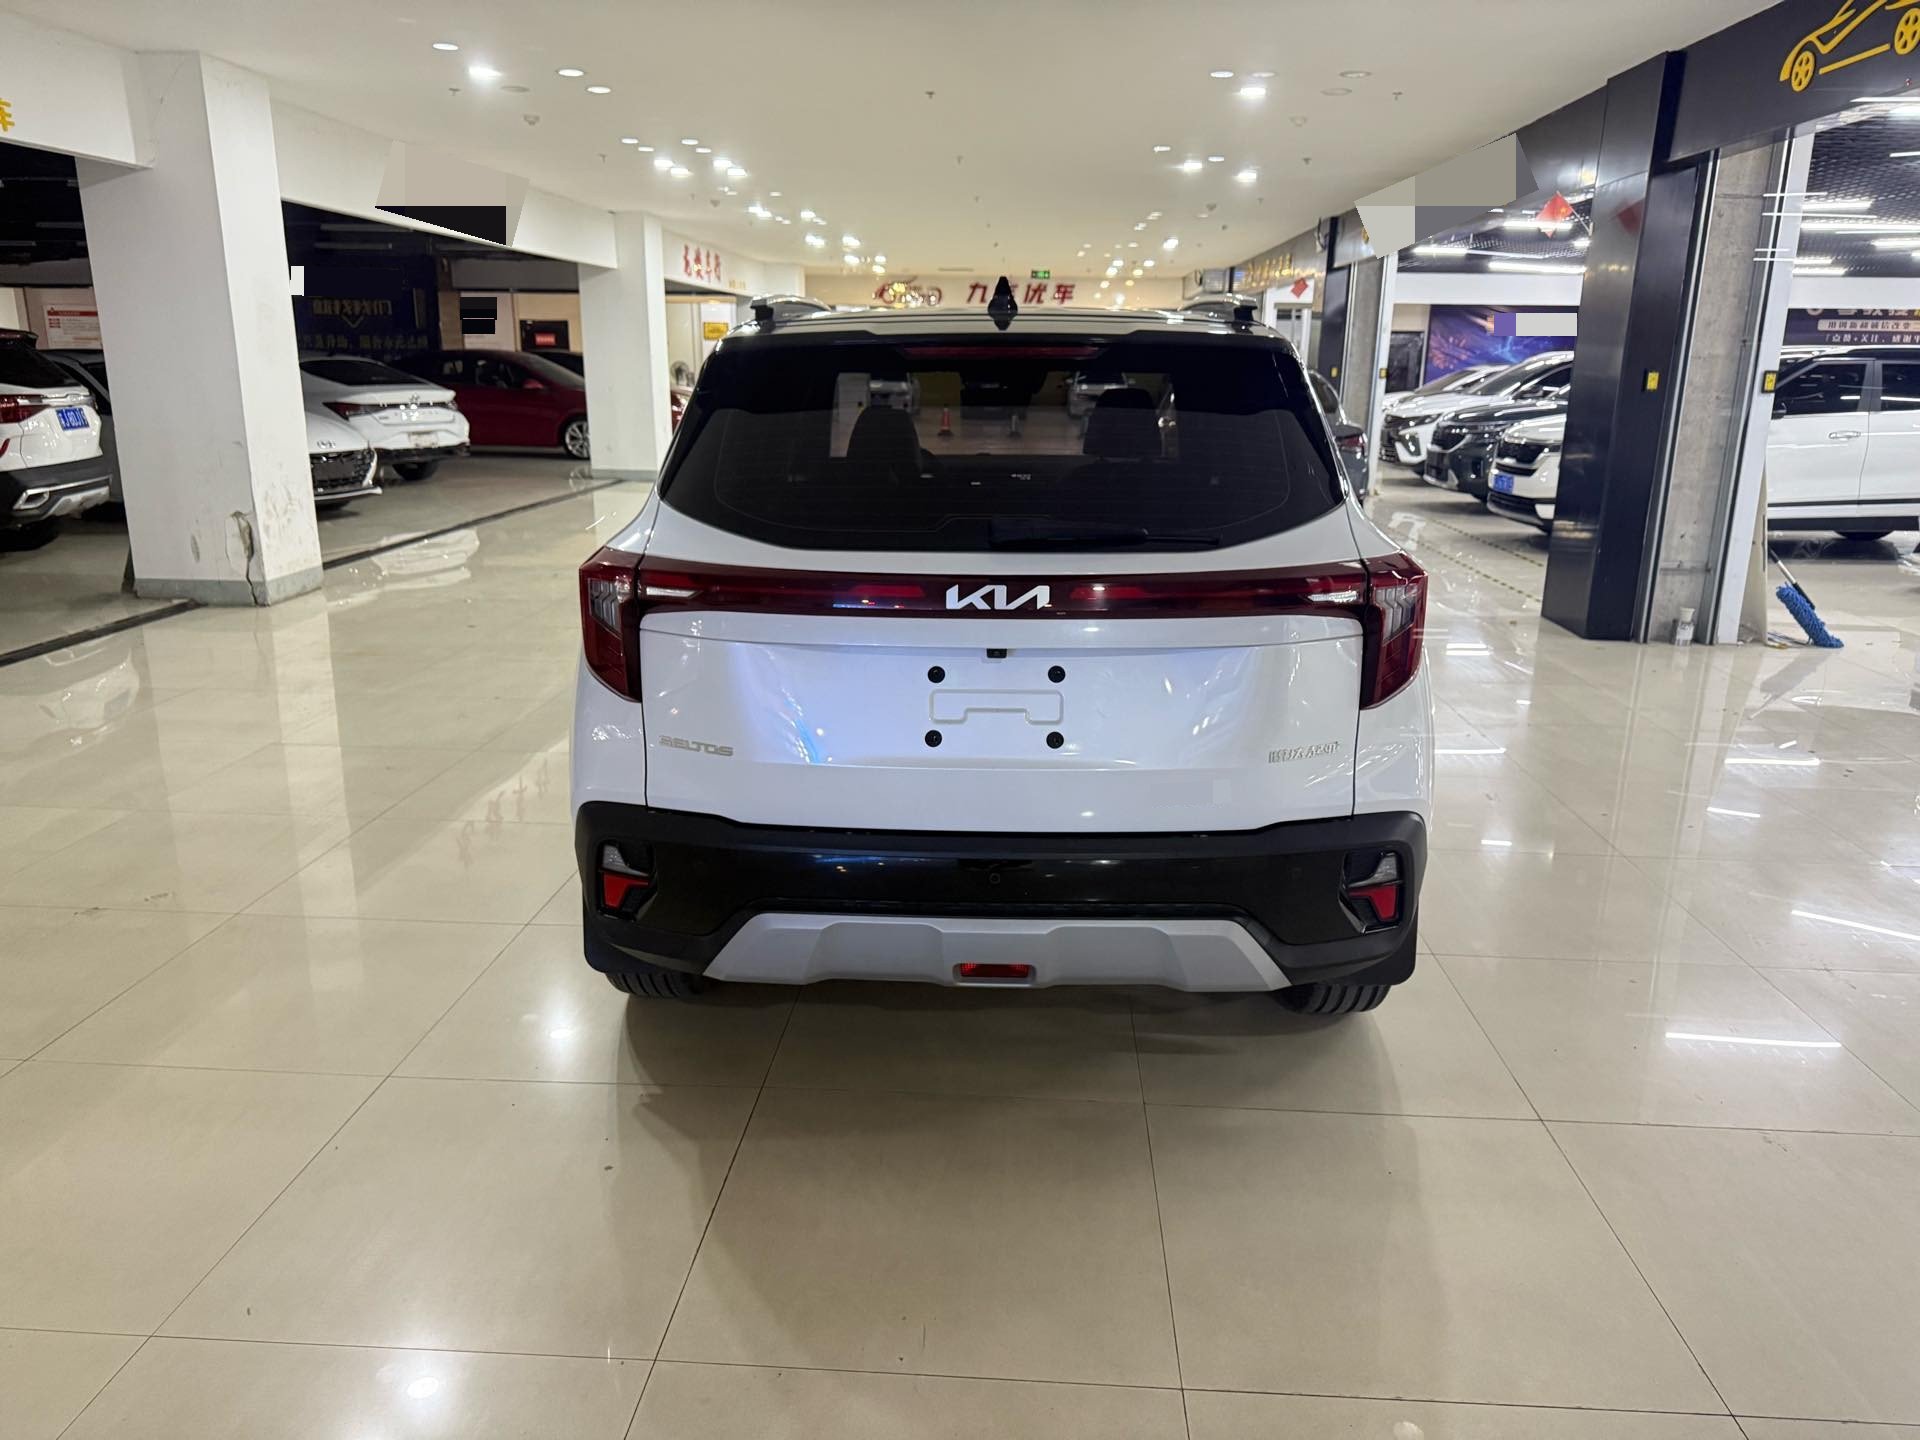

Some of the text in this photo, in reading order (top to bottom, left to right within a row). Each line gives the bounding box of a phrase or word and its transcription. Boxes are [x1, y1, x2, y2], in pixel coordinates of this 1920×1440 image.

[966, 281, 1075, 305] 九优车
[945, 584, 1050, 610] KIA
[658, 735, 734, 757] SELTOS
